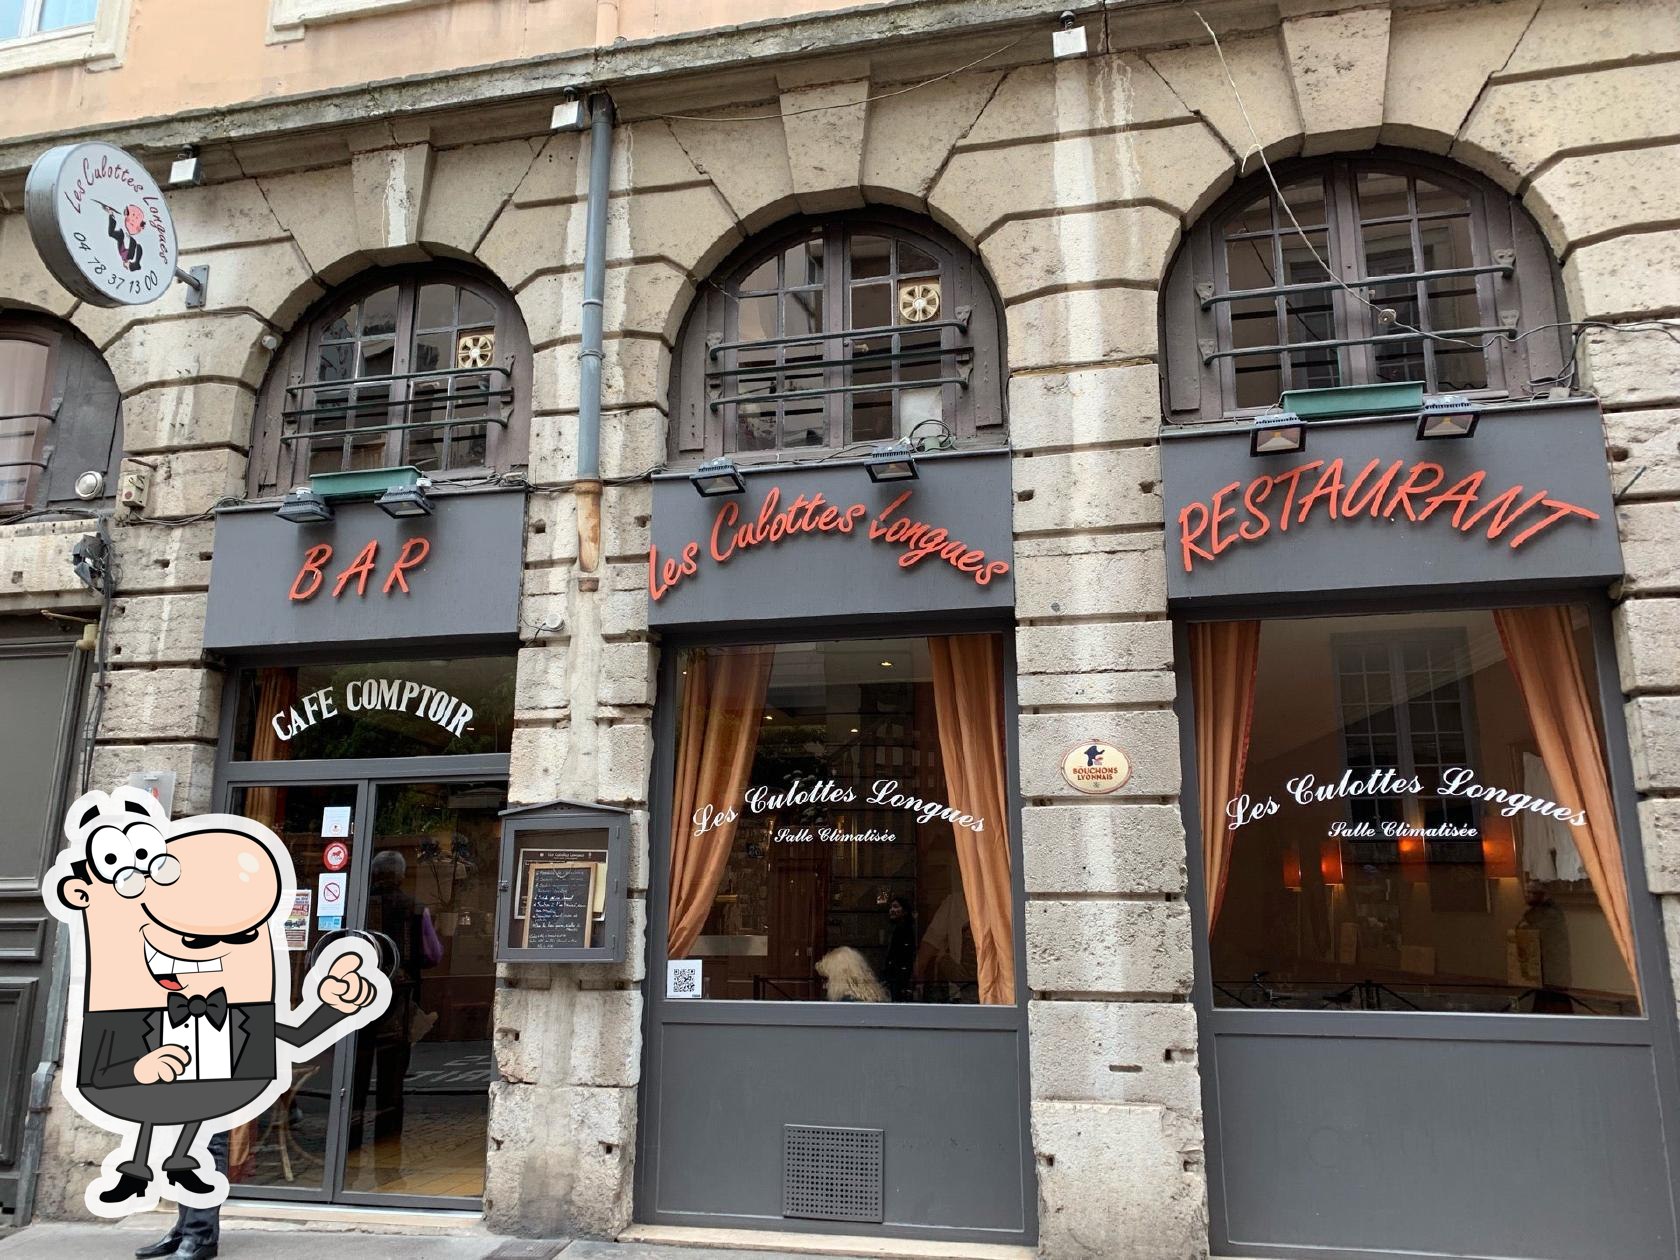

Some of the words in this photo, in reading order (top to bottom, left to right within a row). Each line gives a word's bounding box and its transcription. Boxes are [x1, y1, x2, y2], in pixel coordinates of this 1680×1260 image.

[64, 179, 85, 214] Les
[83, 155, 144, 193] Culottes
[142, 196, 168, 265] Longues
[73, 231, 92, 252] 04
[87, 258, 107, 275] 78
[107, 273, 125, 290] 37
[129, 279, 141, 294] 13
[144, 270, 158, 291] 00
[649, 542, 698, 601] Les
[710, 487, 866, 562] Culottes
[869, 489, 1009, 585] Longues
[1178, 457, 1599, 572] RESTAURANT
[288, 536, 430, 601] BAR
[271, 686, 338, 741] CAFE
[346, 678, 474, 739] COMPTOIR
[692, 803, 738, 837] Les
[745, 780, 856, 814] Culottes
[866, 779, 985, 833] Longues
[1226, 793, 1280, 830] Les
[1286, 768, 1424, 805] Culottes
[1436, 767, 1587, 827] Longues
[1328, 821, 1376, 839] Salle
[1380, 820, 1478, 838] Climatisée
[774, 827, 813, 843] Salle
[818, 827, 896, 843] Climatisée
